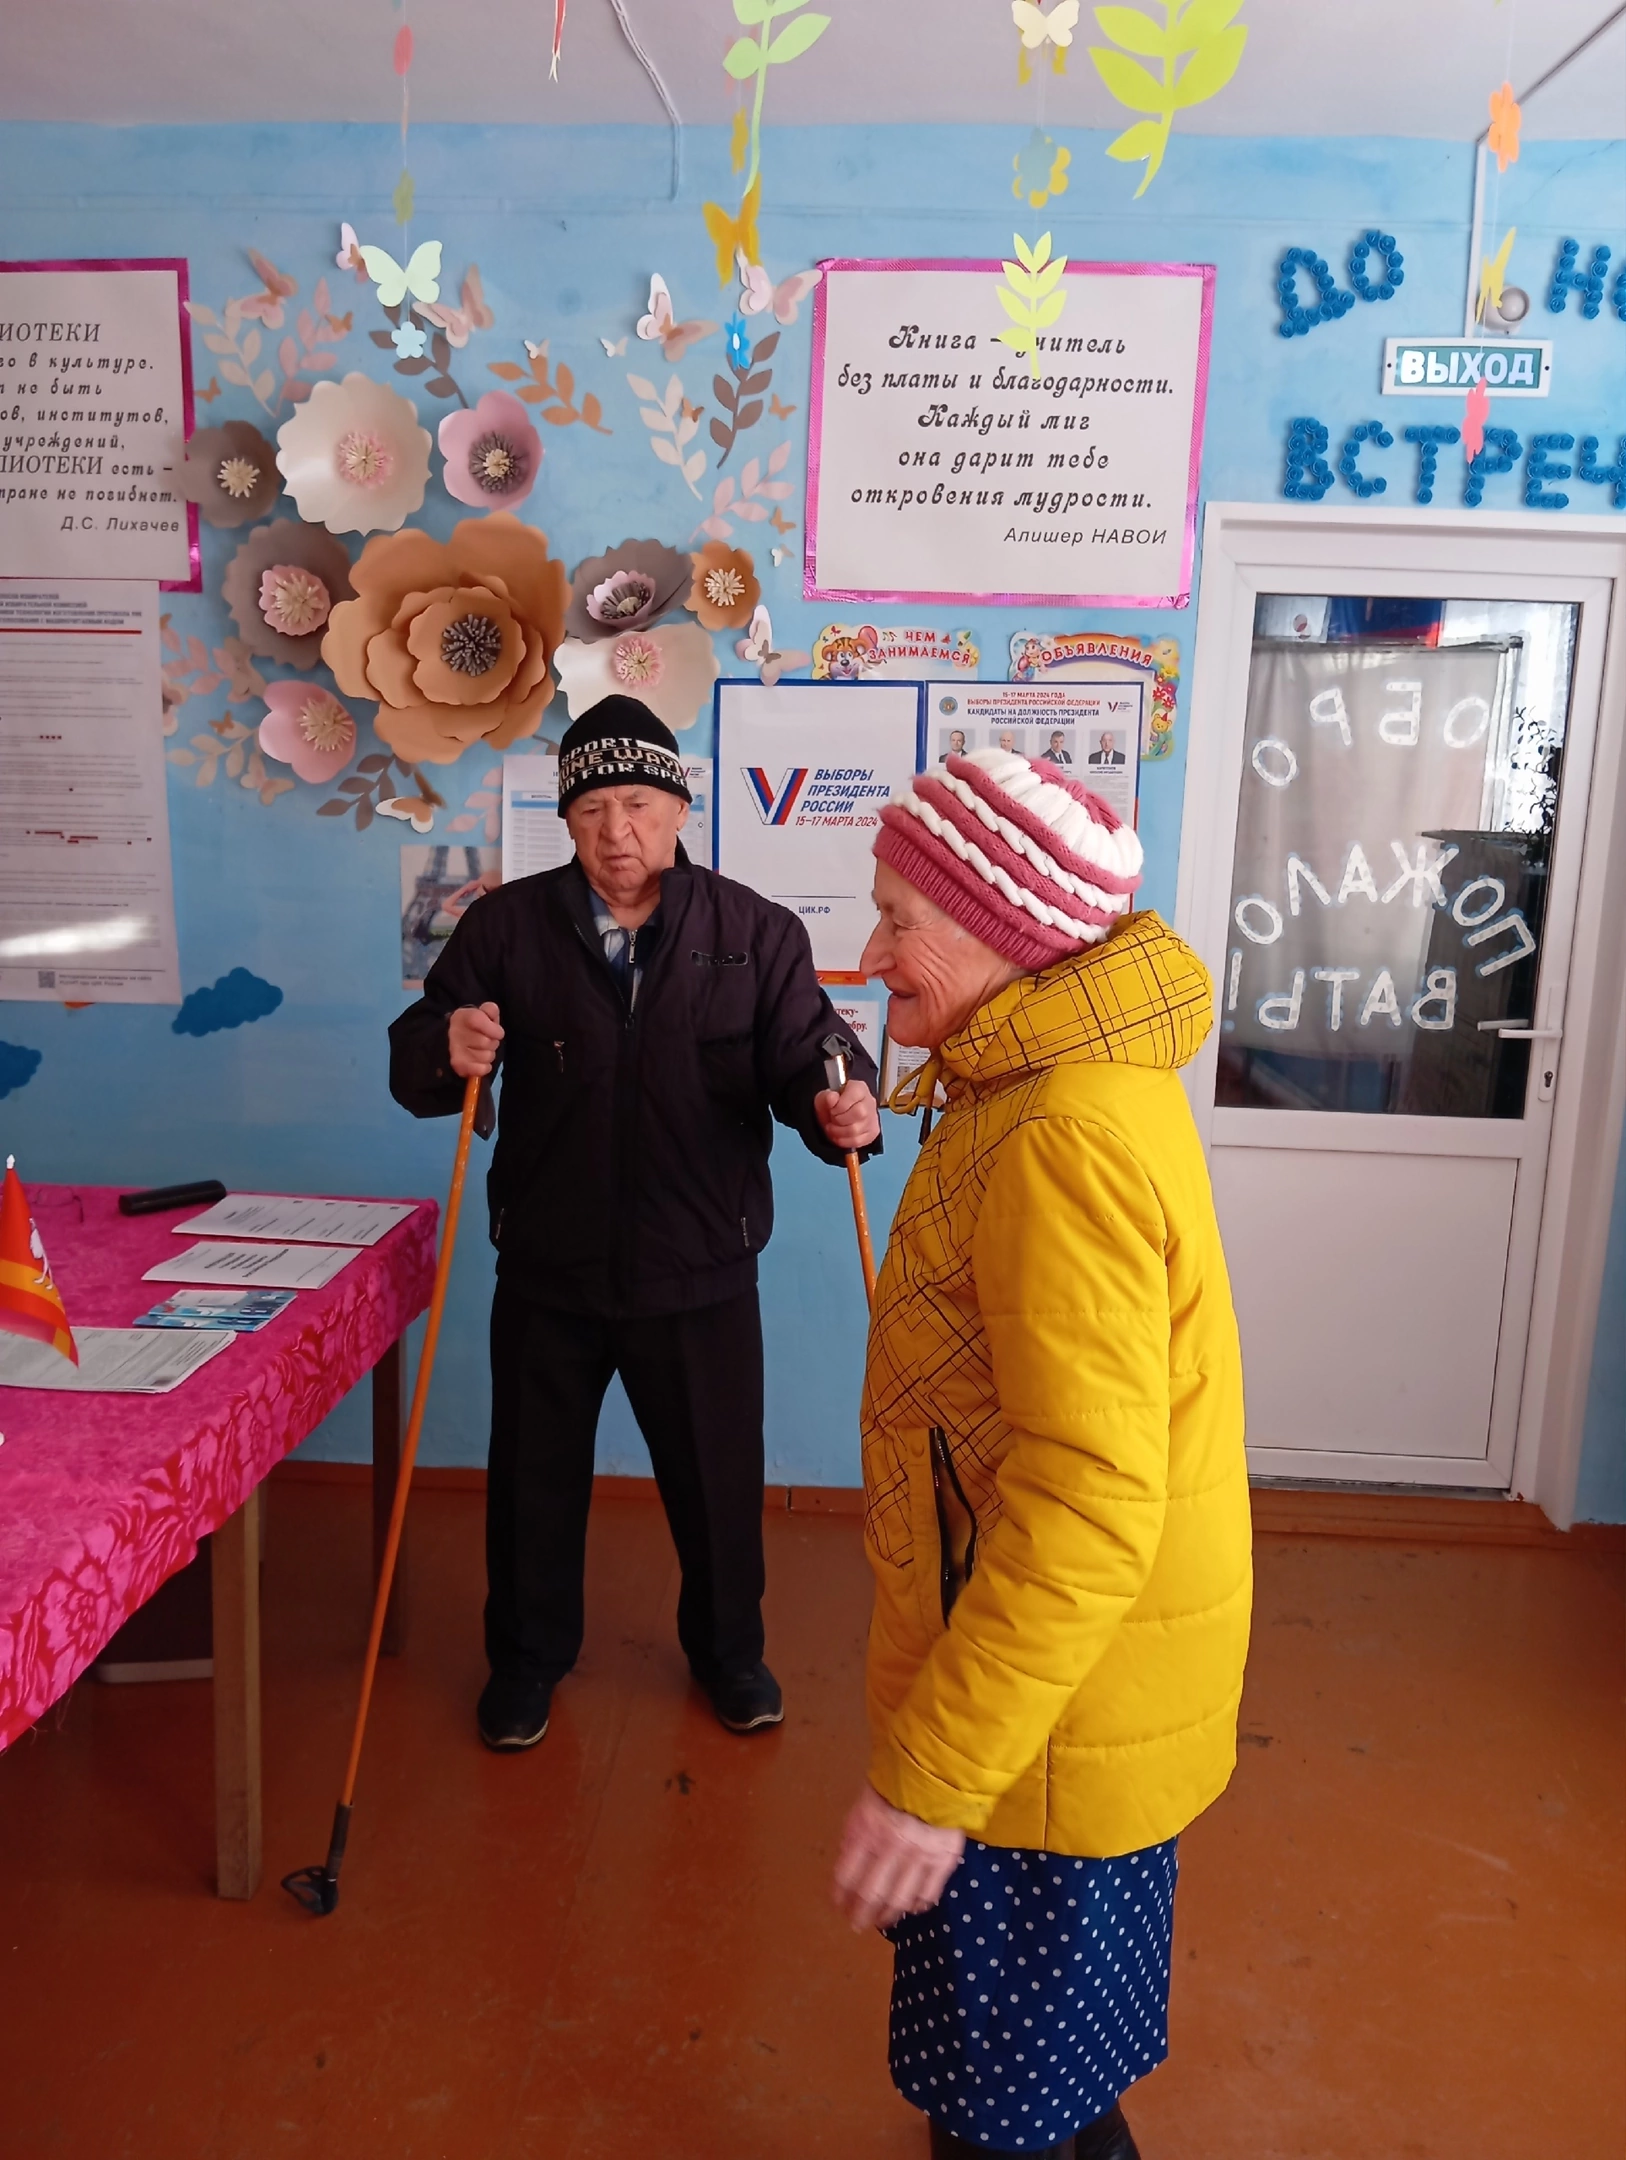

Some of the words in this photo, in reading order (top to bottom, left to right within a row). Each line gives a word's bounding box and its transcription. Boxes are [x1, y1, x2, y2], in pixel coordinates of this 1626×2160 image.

[1277, 229, 1404, 338] ДО
[888, 325, 977, 350] Книга
[29, 352, 38, 368] в
[49, 357, 153, 374] культуре.
[1400, 350, 1534, 385] ВЫХОД
[17, 383, 38, 395] не
[50, 377, 102, 395] быть
[837, 363, 872, 395] без
[881, 371, 958, 390] платы
[969, 374, 981, 389] и
[993, 366, 1174, 398] благодарности.
[37, 407, 168, 427] институтов,
[917, 404, 1031, 436] Каждый
[1040, 415, 1090, 431] миг
[3, 431, 124, 453] учреждений,
[898, 450, 941, 467] она
[951, 450, 1034, 474] дарит
[1047, 446, 1109, 470] тебе
[1283, 417, 1626, 509] ВСТРЕЧ
[111, 464, 154, 476] есть
[57, 489, 76, 500] не
[86, 484, 177, 502] погибнет.
[851, 483, 1004, 511] откровения
[1014, 488, 1152, 513] мудрости.
[106, 517, 180, 532] Лихачев
[1004, 527, 1084, 545] Алишер
[1092, 528, 1167, 545] НАВОИ
[905, 631, 936, 643] ЧЕМ
[869, 646, 970, 664] ЗАНИМАЕМСЯ
[1042, 642, 1153, 667] ОБЪЯВЛЕНИЯ
[993, 698, 1028, 706] ПРЕЗИДЕНТА
[967, 708, 1006, 716] КАНДИДАТЫ
[1059, 709, 1099, 717] ПРЕЗИДЕНТА
[991, 716, 1033, 725] РОССИЙСКОЙ
[1035, 717, 1075, 726] ФЕДЕРАЦИИ
[561, 737, 632, 766] SPORT
[582, 762, 635, 780] FOR
[814, 768, 874, 781] ВЫБОРЫ
[807, 785, 890, 798] ПРЕЗИДЕНТА
[800, 800, 854, 813] РОССИИ
[822, 816, 854, 826] МАРТА
[855, 816, 878, 827] 2024
[799, 905, 831, 916] ЦИК.РФ
[834, 1008, 859, 1018] теку-
[848, 1020, 867, 1032] бру.
